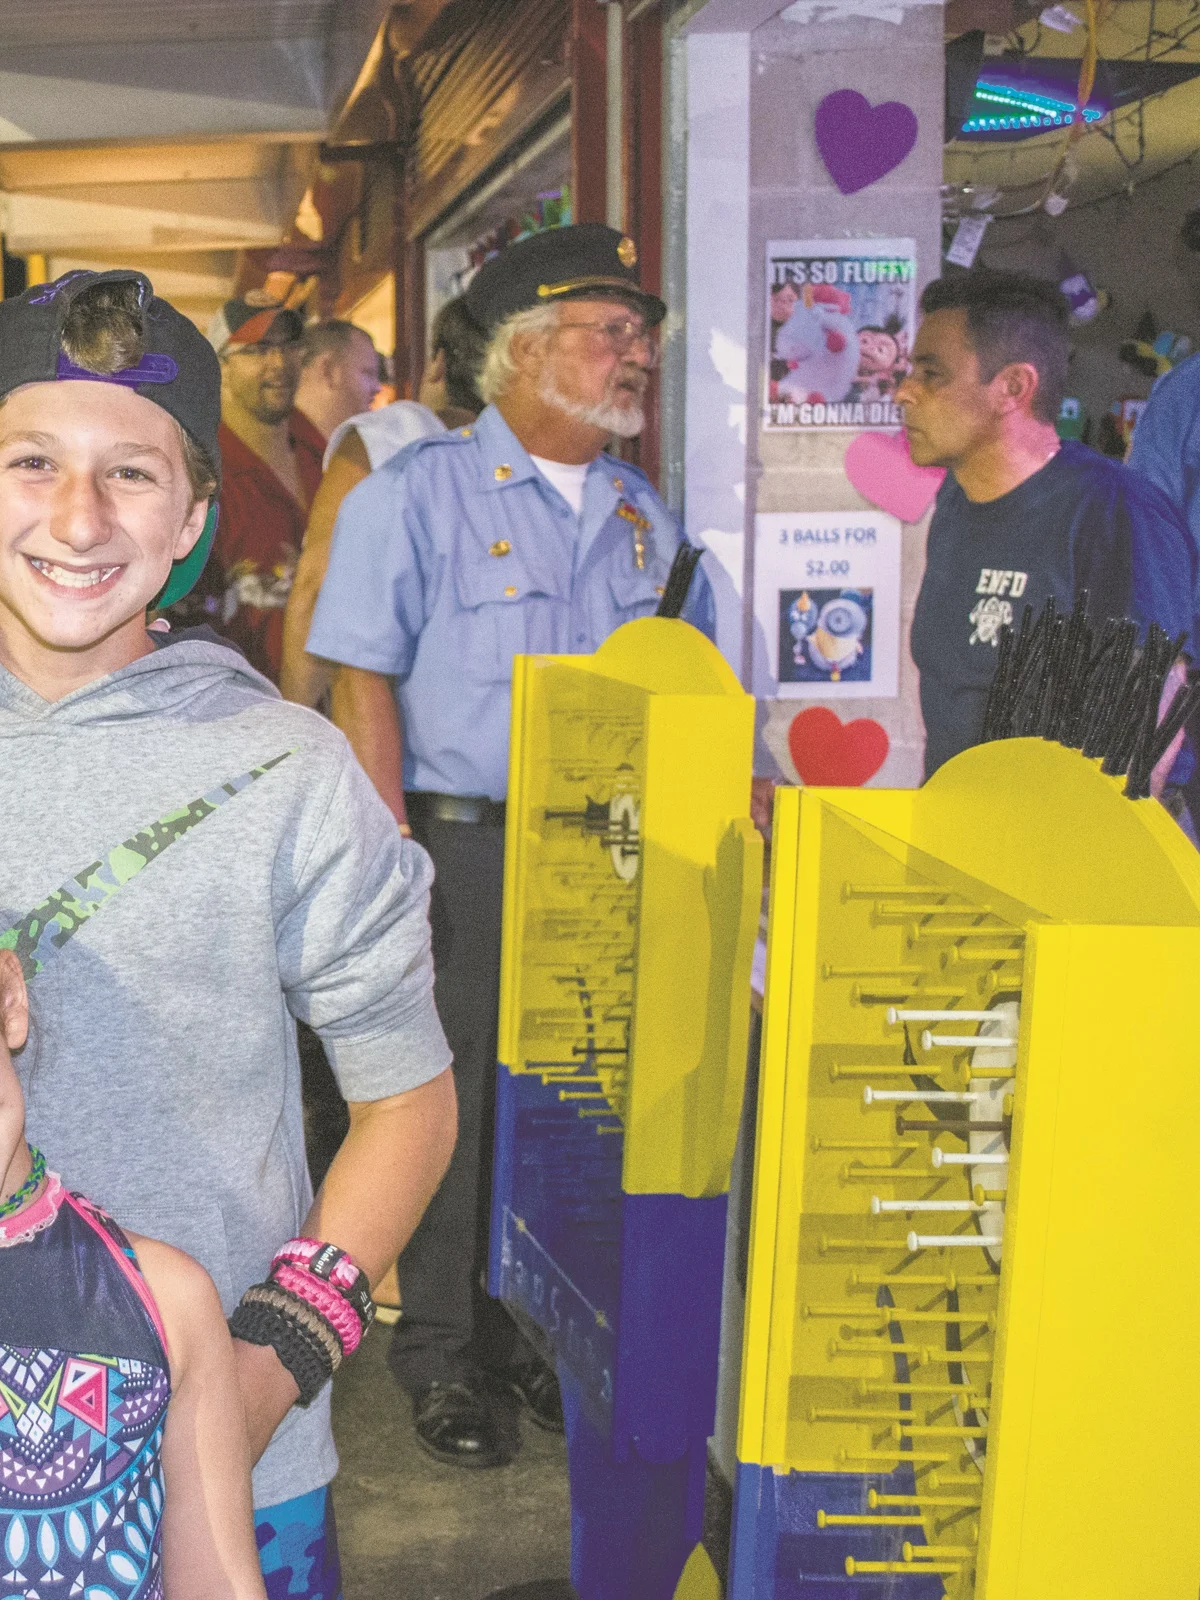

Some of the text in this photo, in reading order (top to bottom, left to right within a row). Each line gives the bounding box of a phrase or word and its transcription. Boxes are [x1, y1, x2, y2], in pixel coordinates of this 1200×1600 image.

[810, 261, 838, 284] SO
[842, 260, 912, 284] FLUFFY
[800, 402, 866, 424] GONNA
[779, 527, 877, 544] 3 BALLS FOR
[806, 559, 850, 576] $2.00
